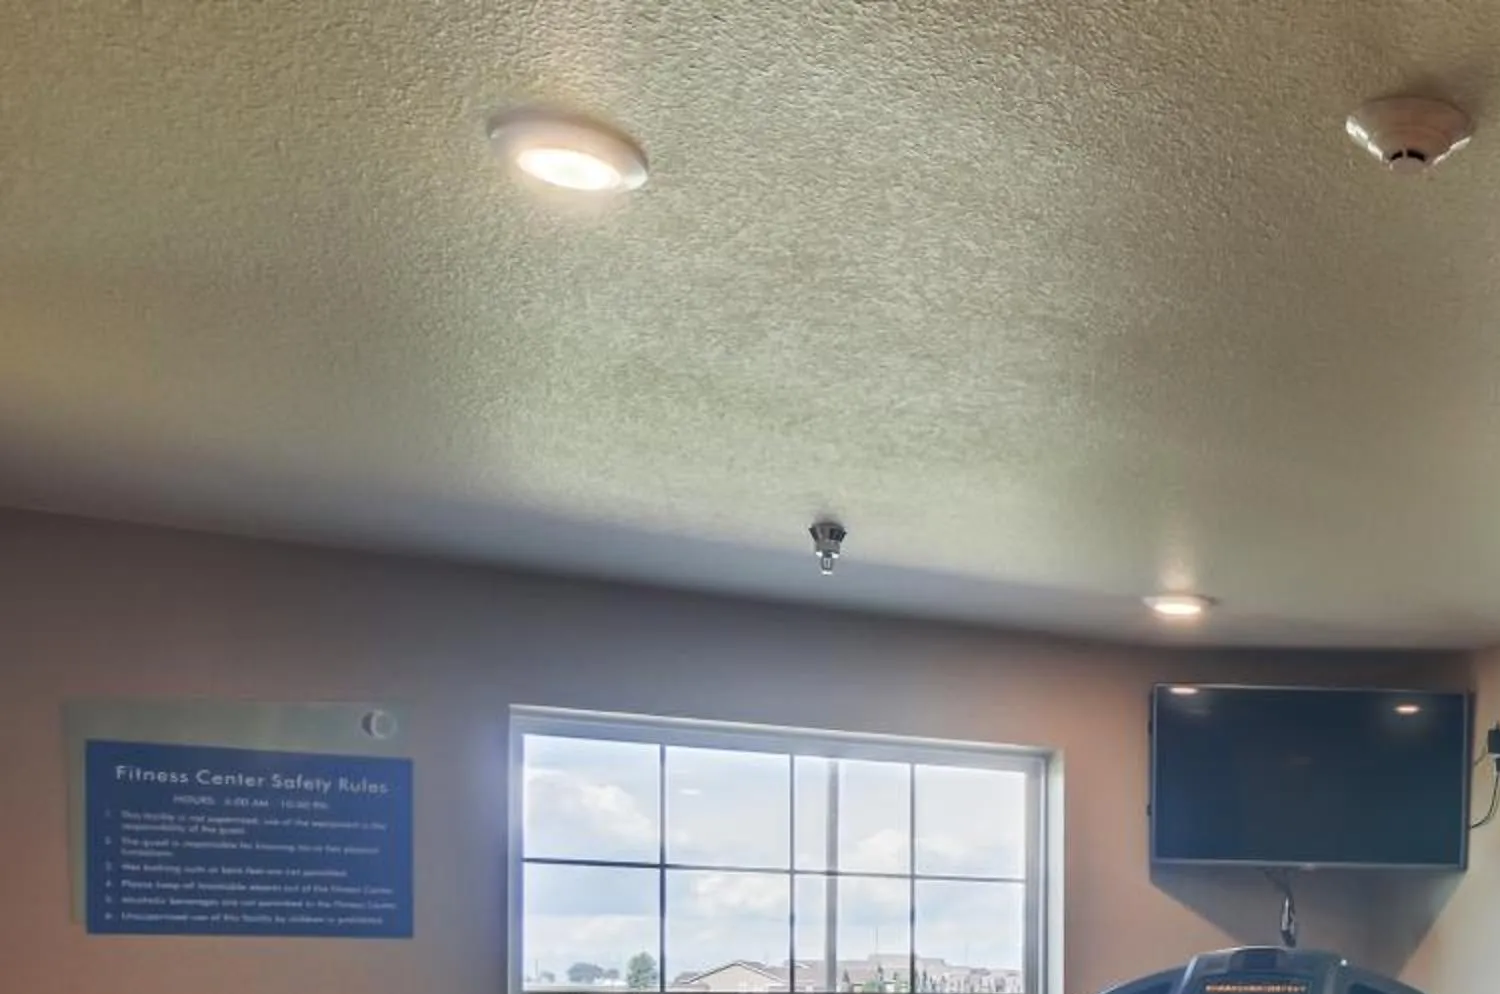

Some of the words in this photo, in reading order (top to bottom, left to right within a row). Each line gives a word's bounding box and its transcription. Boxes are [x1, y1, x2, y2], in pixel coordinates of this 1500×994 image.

[115, 765, 189, 784] Fitness
[195, 769, 266, 788] Center
[272, 773, 332, 794] Safety
[339, 777, 389, 794] Rules
